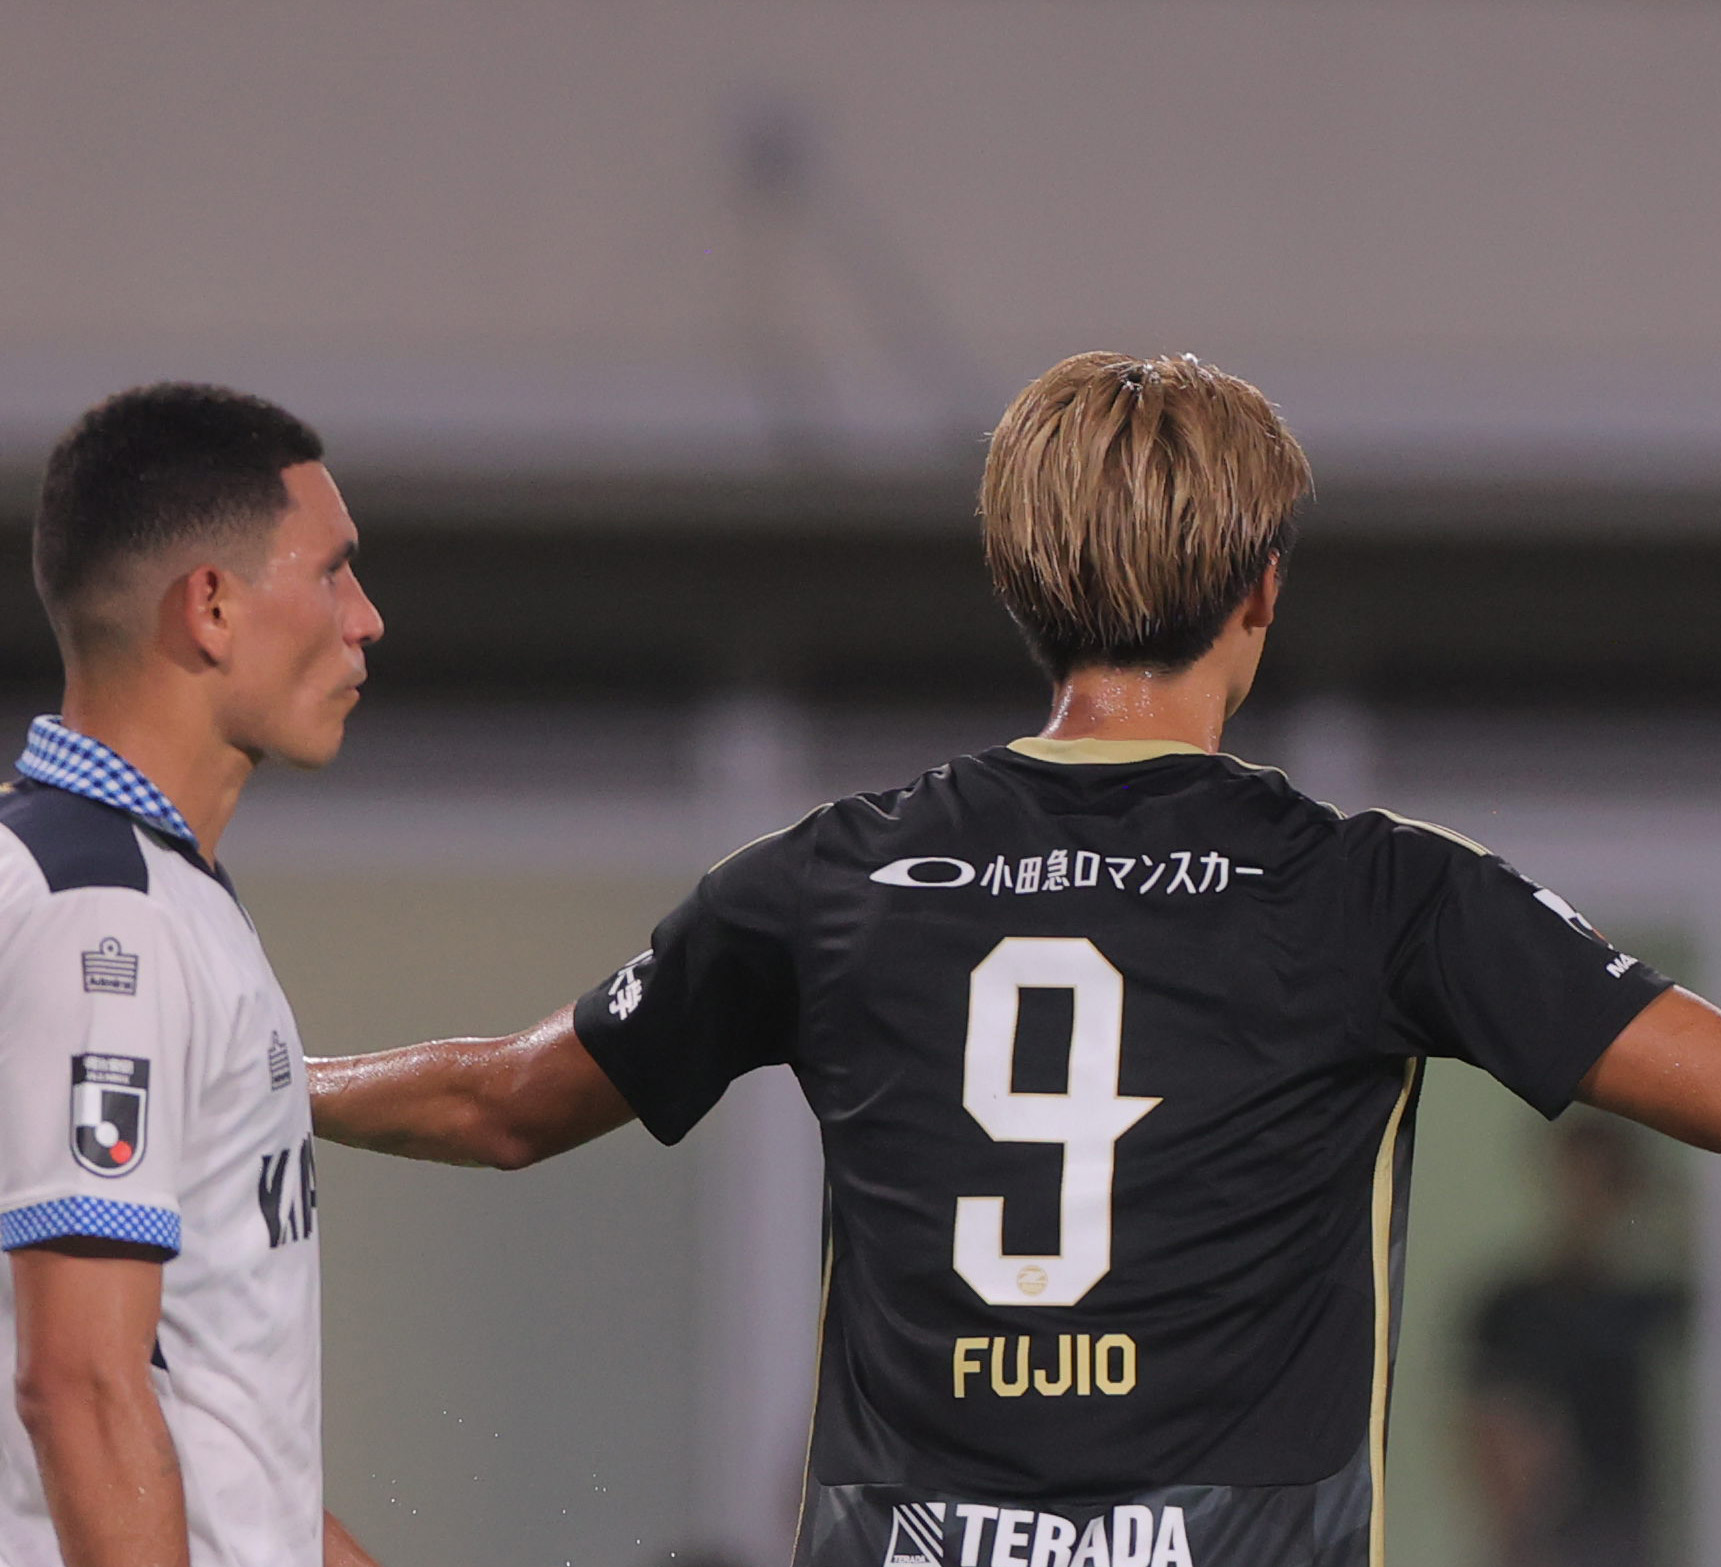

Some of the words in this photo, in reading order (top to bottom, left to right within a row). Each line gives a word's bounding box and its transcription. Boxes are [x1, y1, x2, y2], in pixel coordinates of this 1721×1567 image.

[980, 849, 1264, 896] 小田急ロマンスカー
[953, 937, 1164, 1307] 9
[953, 1333, 1137, 1398] FUJIO
